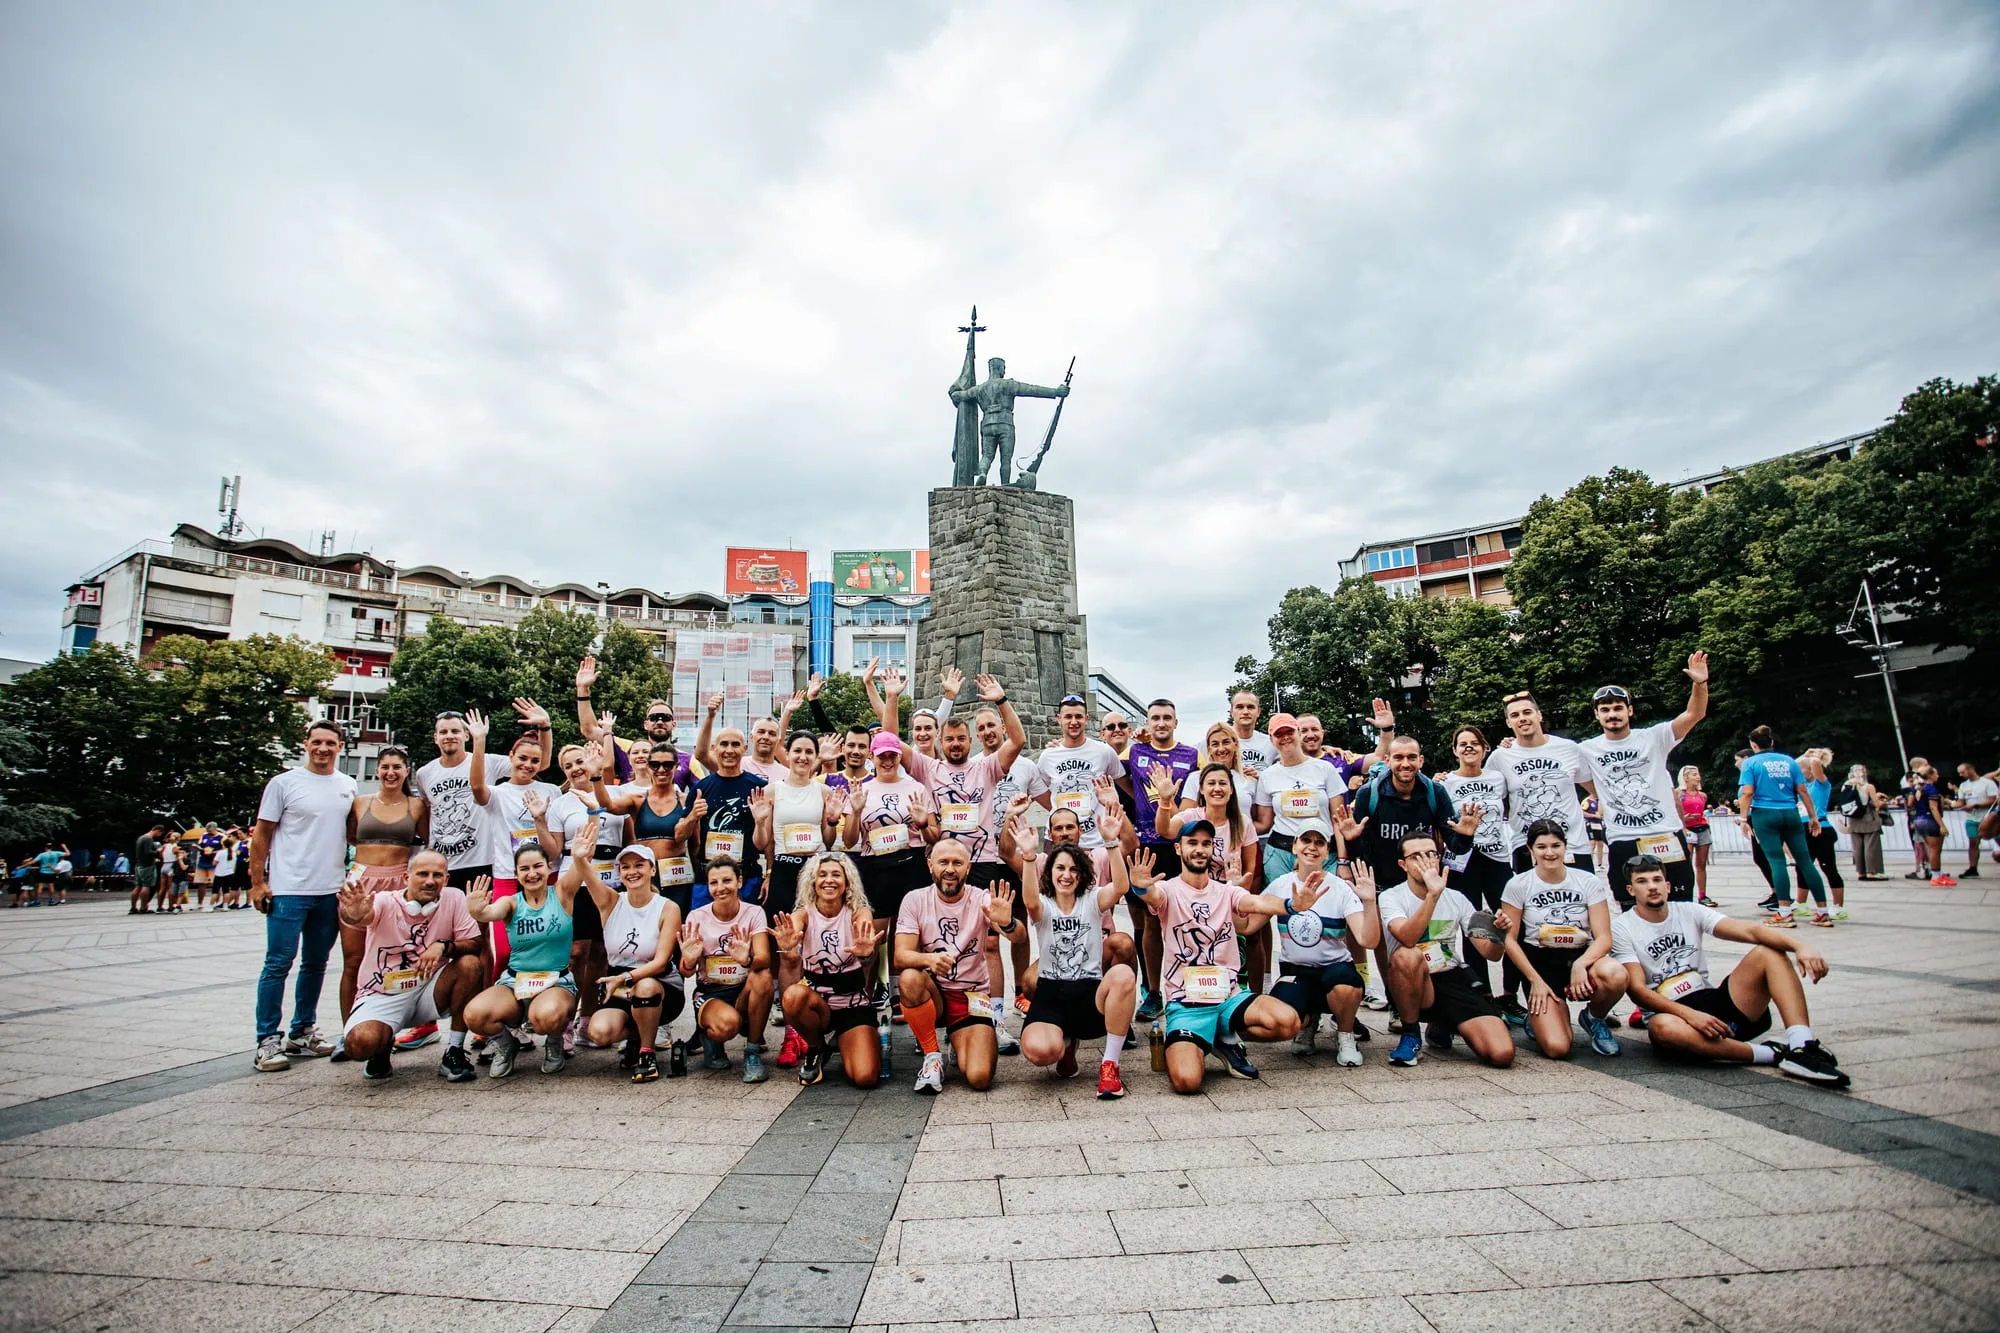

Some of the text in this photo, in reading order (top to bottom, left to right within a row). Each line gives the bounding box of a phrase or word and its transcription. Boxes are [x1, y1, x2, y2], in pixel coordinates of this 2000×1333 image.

[1242, 750, 1265, 762] SOMA
[1597, 751, 1638, 766] 36SOMA
[1056, 760, 1091, 774] 36SOMA
[1515, 759, 1559, 775] 36SOMA
[1456, 783, 1494, 797] 36SOMA
[1292, 799, 1309, 808] 1302
[953, 813, 969, 822] 1192
[1614, 808, 1663, 827] RUNNERS
[882, 834, 898, 845] 1191
[434, 836, 475, 855] RUNNERS
[716, 843, 732, 852] 1143
[1653, 845, 1670, 855] 1121
[780, 856, 803, 865] PRO
[600, 872, 613, 881] 757
[672, 867, 686, 876] 1241
[1532, 890, 1580, 908] 36SOMA
[517, 918, 544, 935] BRC
[1554, 936, 1575, 944] 1280
[1648, 935, 1686, 958] 36SOMA
[719, 966, 738, 975] 1082
[1198, 977, 1218, 987] 1003
[1674, 981, 1691, 994] 1123
